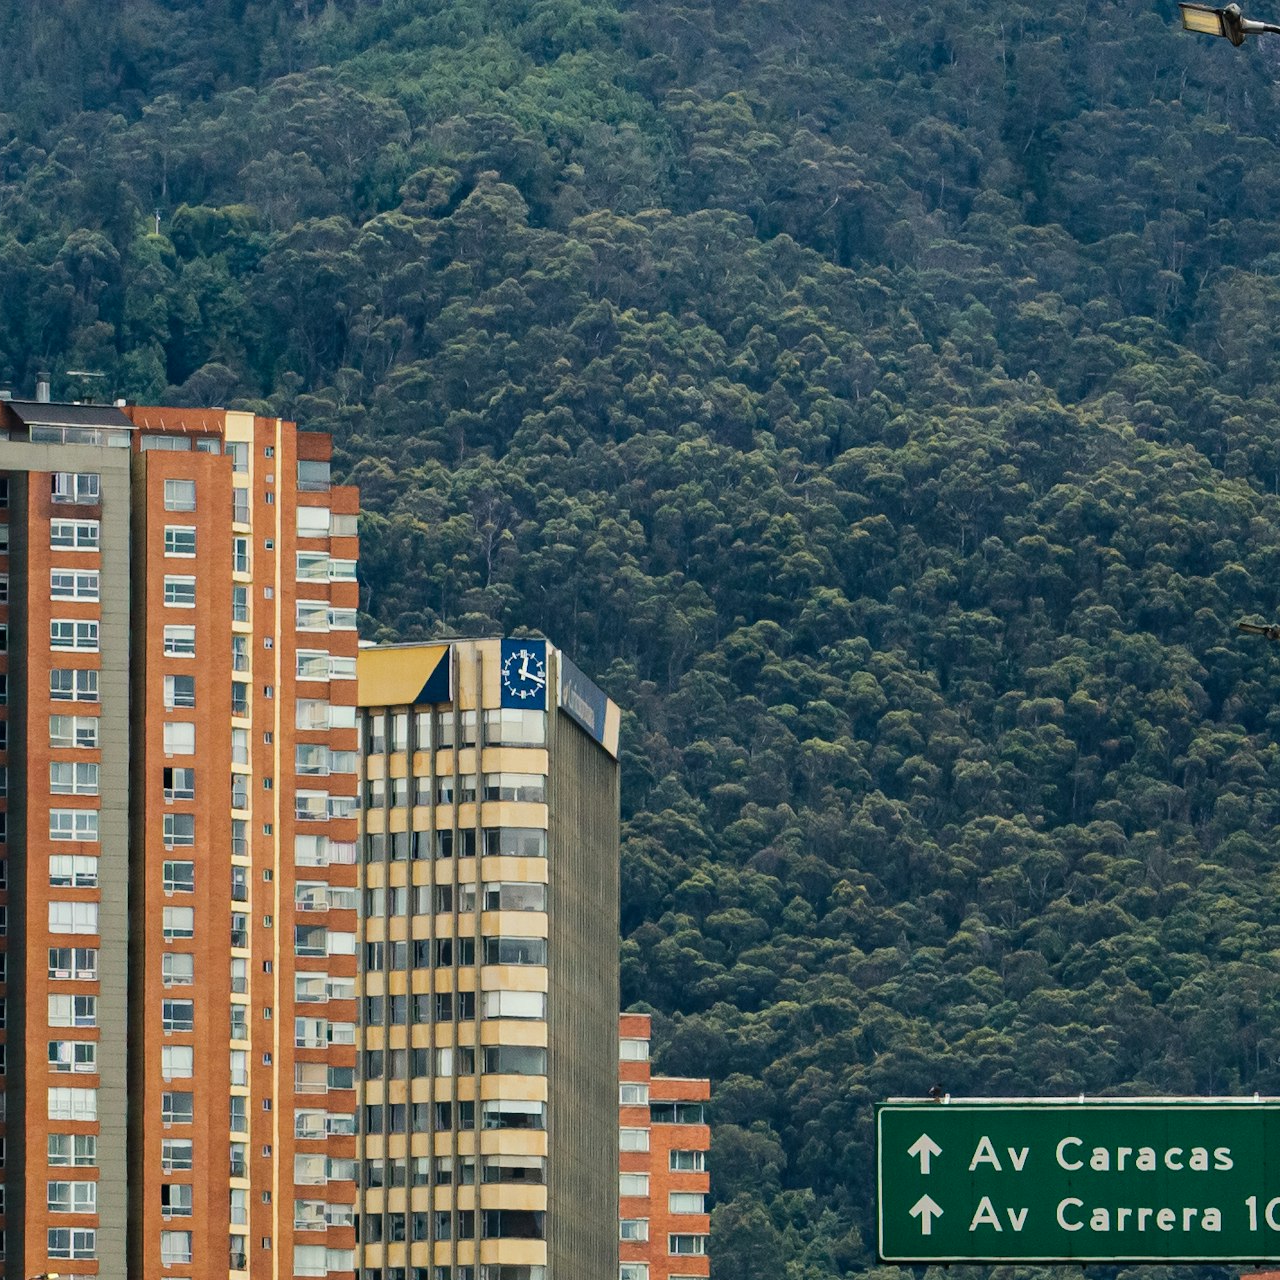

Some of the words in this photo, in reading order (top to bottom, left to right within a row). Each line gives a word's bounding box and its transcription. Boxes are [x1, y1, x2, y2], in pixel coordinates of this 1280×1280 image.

[968, 1135, 1029, 1171] Av
[1055, 1136, 1234, 1171] Caracas
[968, 1196, 1029, 1232] Av
[1056, 1197, 1221, 1232] Carrera
